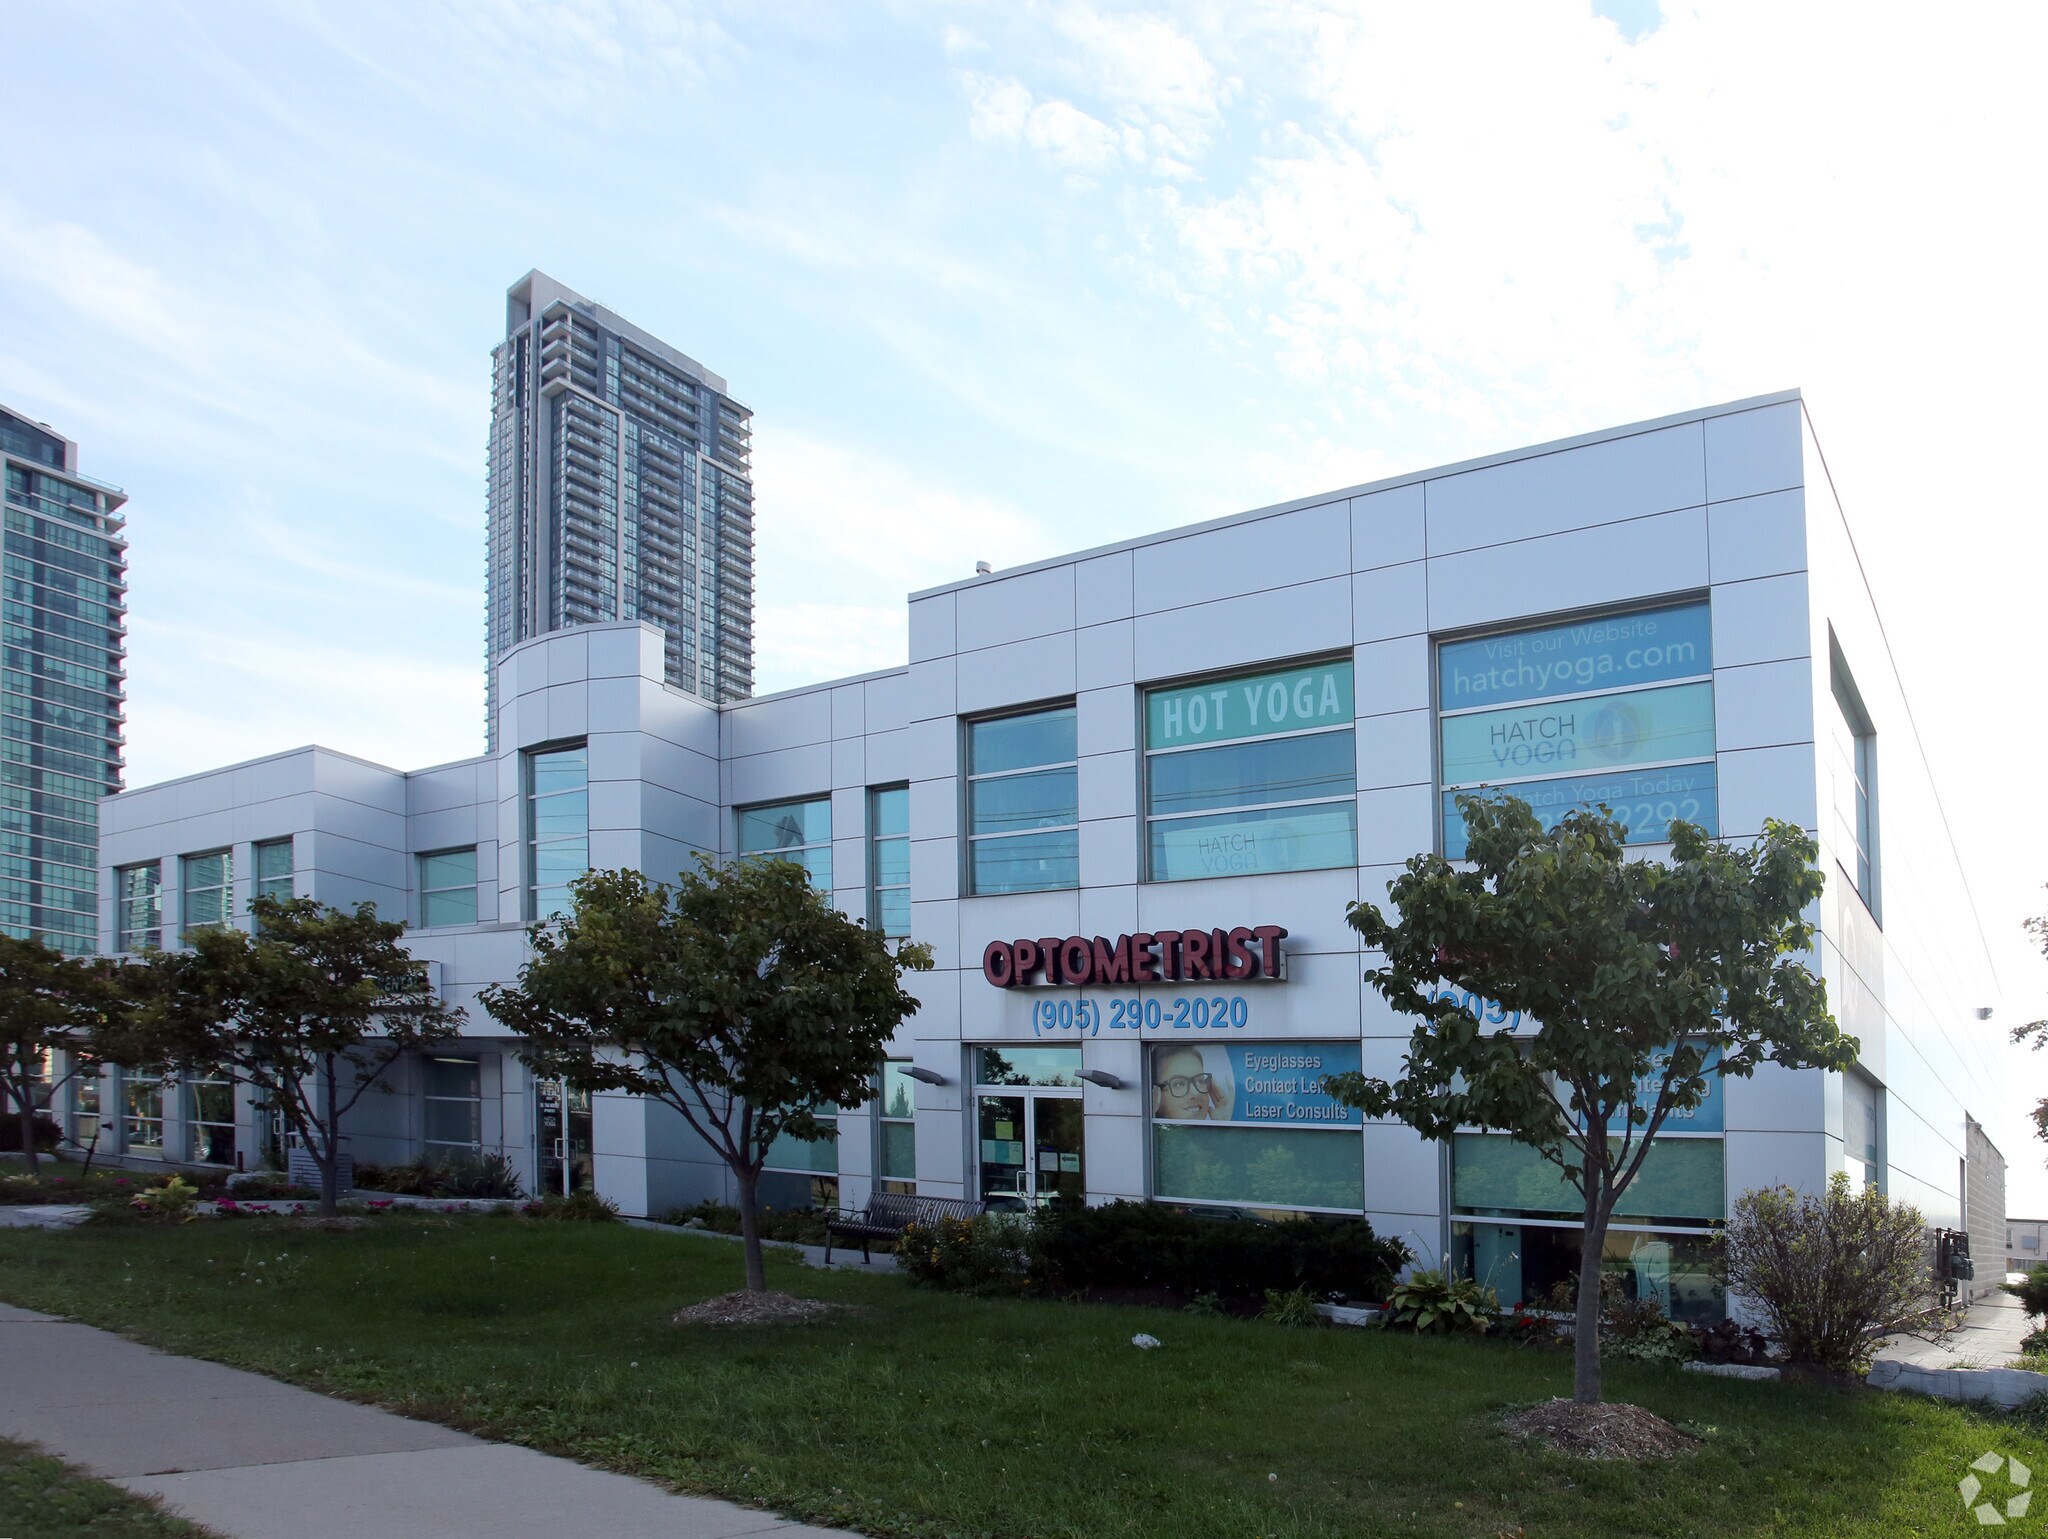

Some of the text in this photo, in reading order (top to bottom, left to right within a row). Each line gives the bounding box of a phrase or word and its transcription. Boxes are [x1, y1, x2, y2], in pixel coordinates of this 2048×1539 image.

[1485, 619, 1657, 660] Visit our Website
[1454, 641, 1695, 694] hatchyoga.com
[1163, 674, 1340, 738] HOT YOGA
[1491, 714, 1575, 745] HATCH
[1492, 738, 1577, 767] YOGA
[1516, 784, 1565, 808] atch
[1571, 783, 1623, 805] Yoga
[1629, 773, 1695, 797] Today
[1198, 833, 1256, 855] HATCH
[1201, 852, 1258, 873] YOGA
[983, 925, 1288, 987] OPTOMETRIST
[1032, 996, 1248, 1036] (905) 290-2020
[1245, 1052, 1322, 1073] Eyeglasses
[1245, 1077, 1298, 1095] Contact
[1246, 1101, 1349, 1120] Laser Consults
